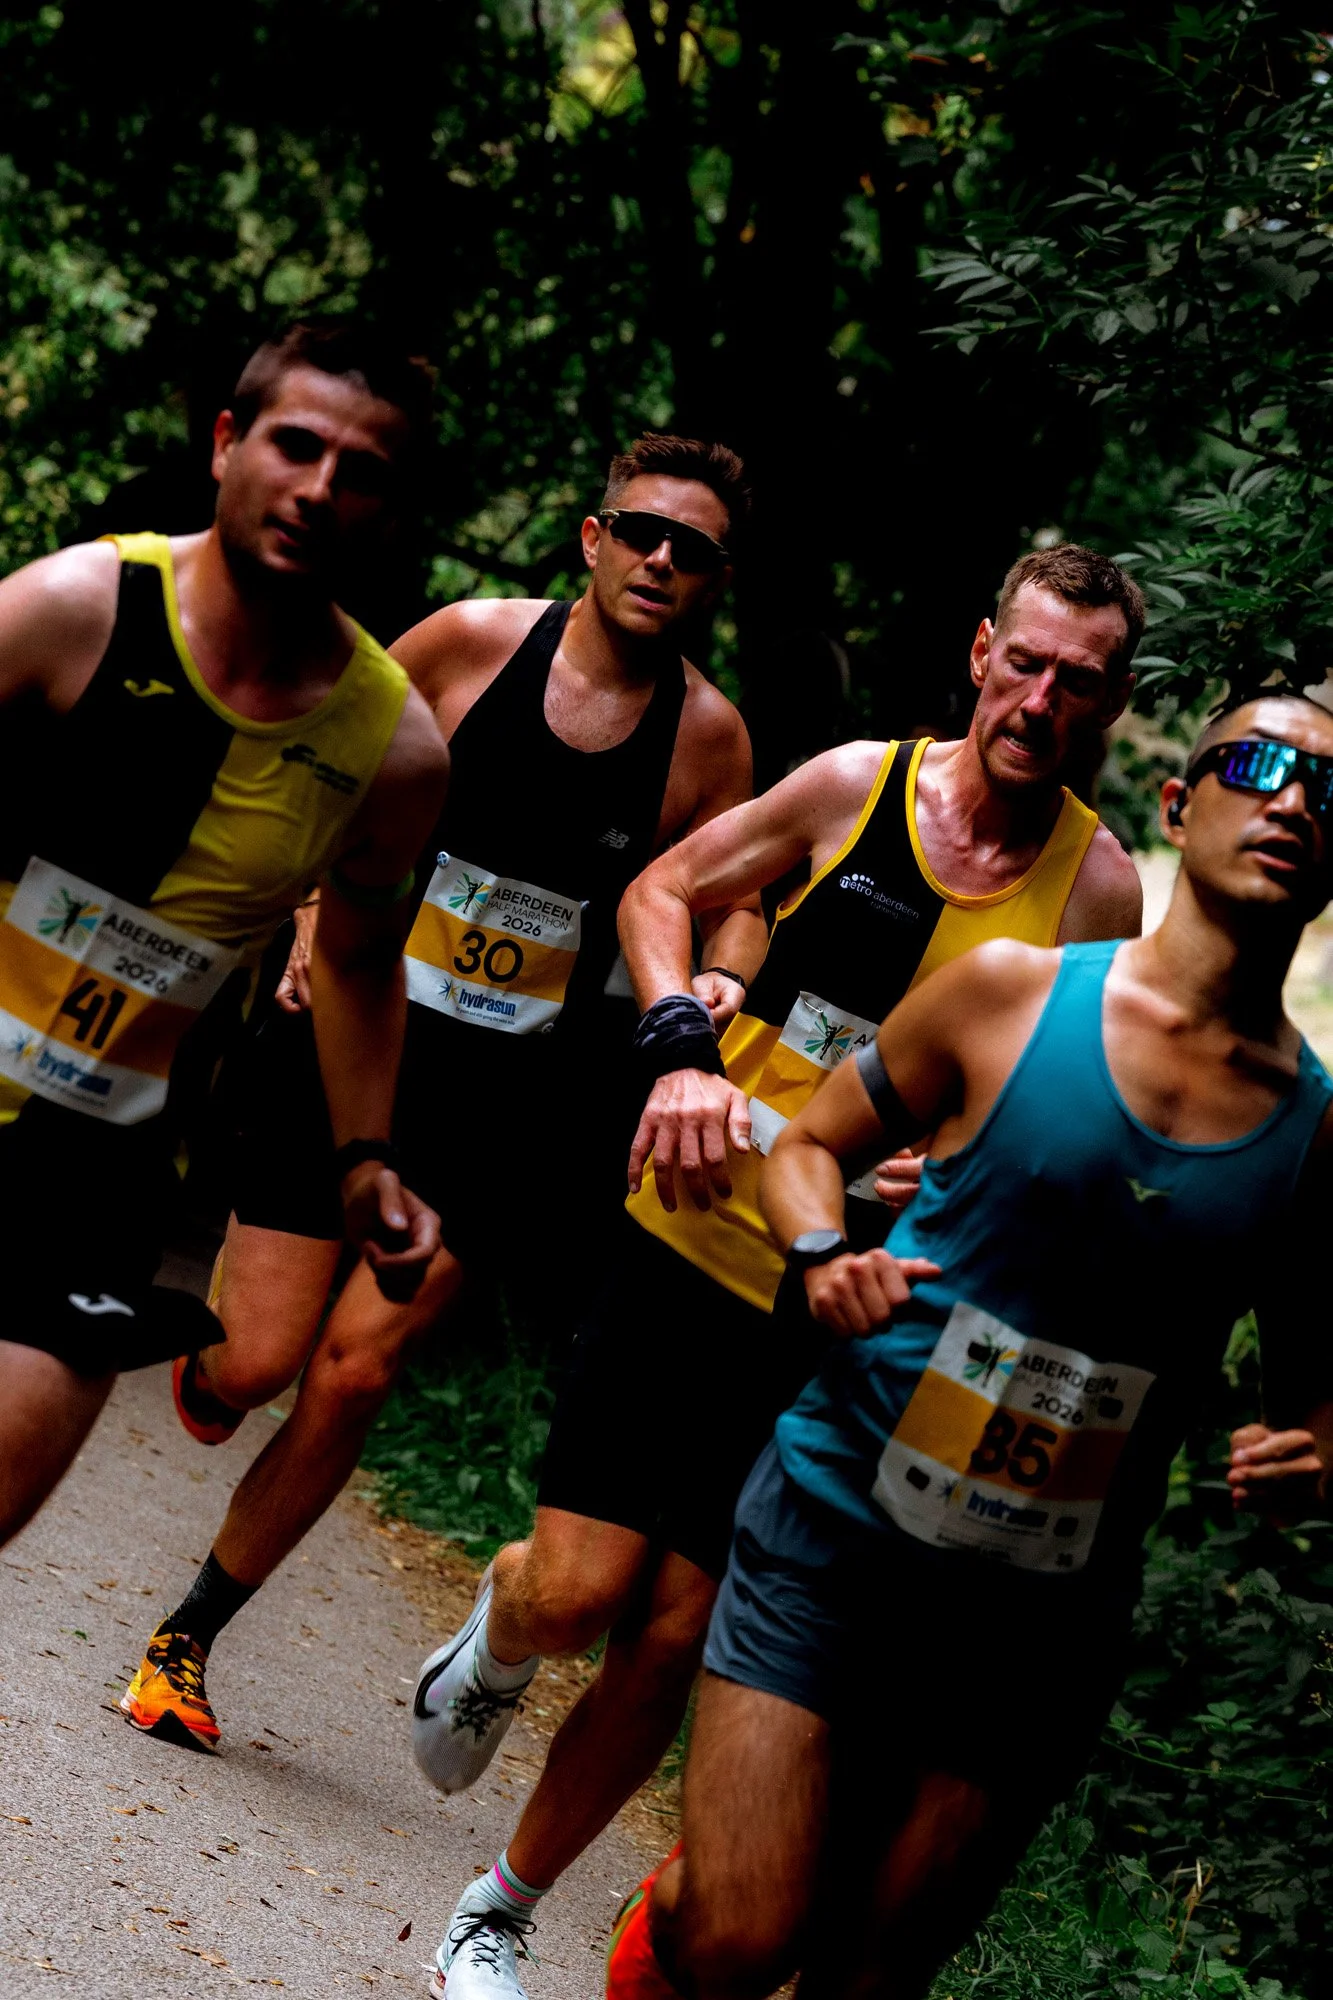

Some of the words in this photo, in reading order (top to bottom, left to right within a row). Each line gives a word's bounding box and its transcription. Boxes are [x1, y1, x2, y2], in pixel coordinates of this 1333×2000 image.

[491, 887, 574, 922] ABERDEEN
[839, 875, 872, 897] metro
[873, 891, 920, 920] aberdeen
[486, 900, 512, 916] HALF
[512, 905, 570, 932] MARATHON
[501, 915, 542, 937] 2026
[102, 912, 212, 973] ABERDEEN
[453, 930, 524, 983] 30
[113, 956, 169, 994] 2026
[60, 978, 128, 1049] 41
[458, 988, 517, 1017] hydrasun
[1032, 1391, 1084, 1426] 2026
